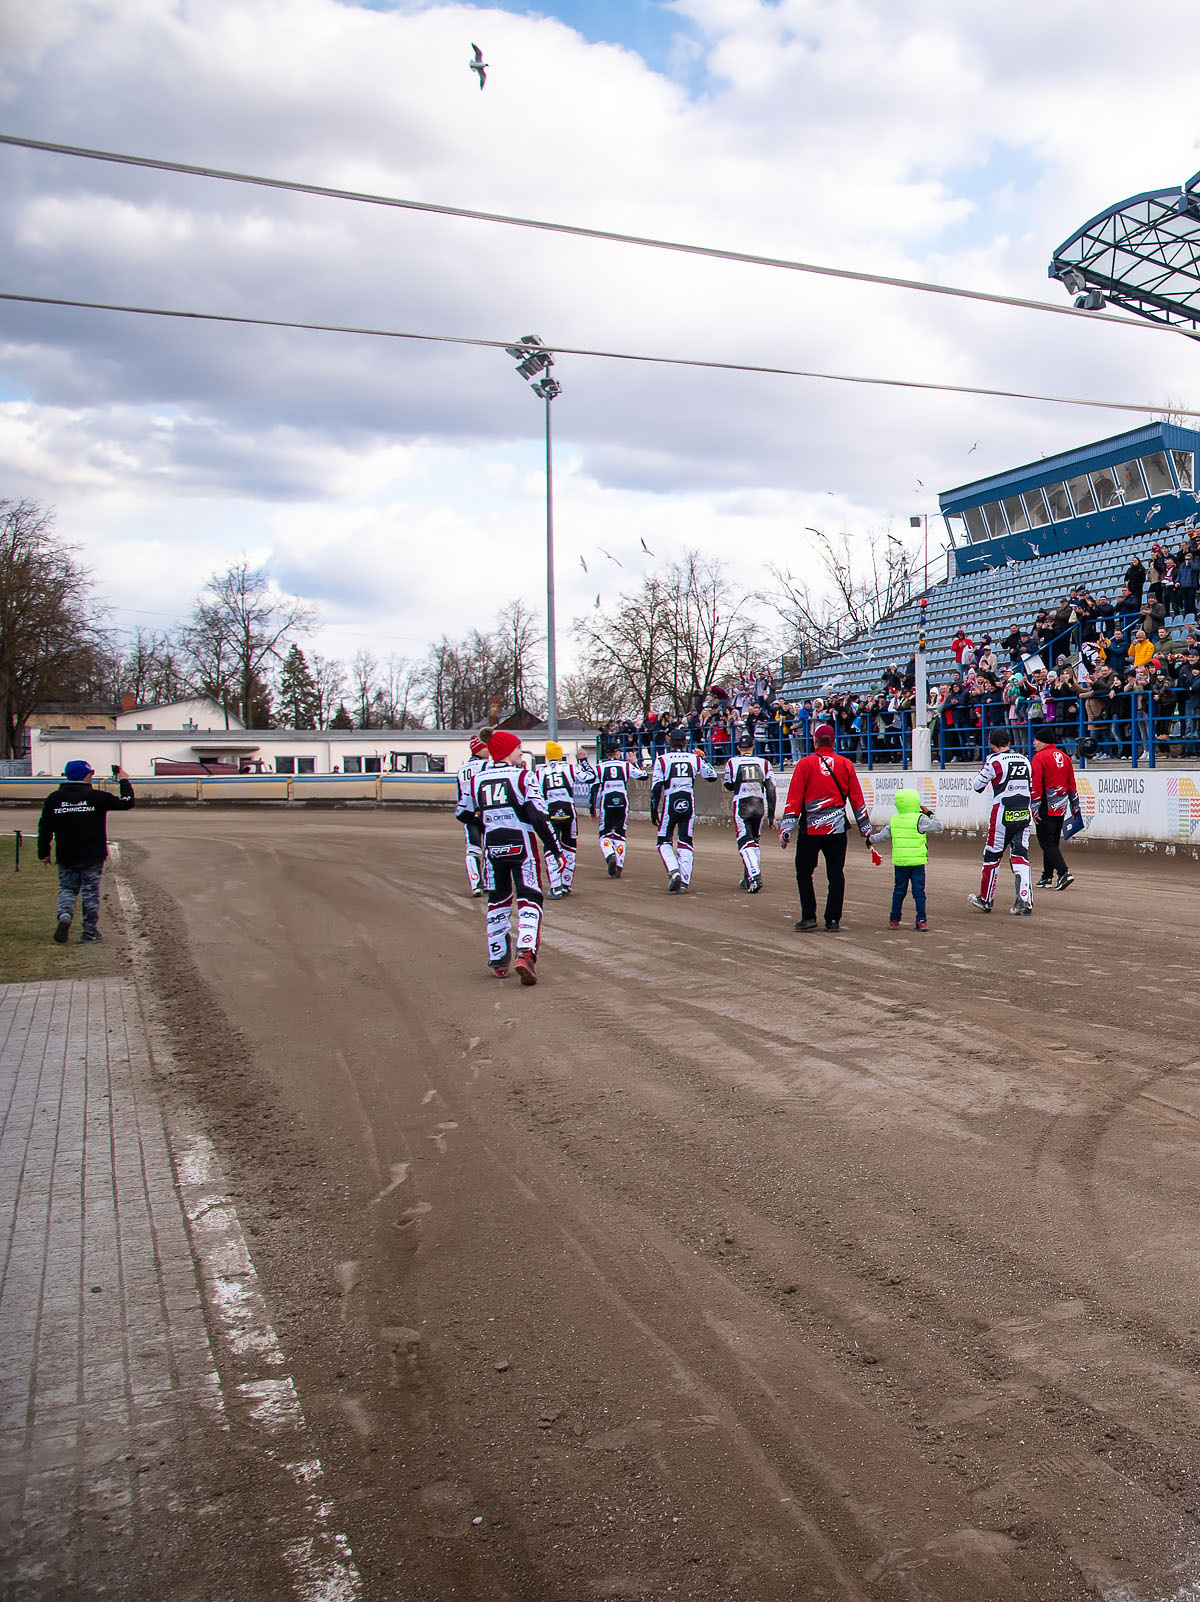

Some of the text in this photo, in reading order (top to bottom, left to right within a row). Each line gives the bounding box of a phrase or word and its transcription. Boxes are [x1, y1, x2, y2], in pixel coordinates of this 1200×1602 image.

[462, 769, 472, 782] 10
[610, 766, 618, 779] 9
[674, 762, 689, 777] 12
[743, 766, 756, 779] 11
[1010, 766, 1027, 776] 13
[546, 774, 563, 788] 15
[875, 778, 904, 790] DAUGAVPILS
[939, 778, 973, 791] DAUGAVPILS
[1098, 778, 1145, 794] DAUGAVPILS
[482, 783, 508, 806] 14
[944, 795, 970, 808] SPEEDWAY
[1098, 799, 1141, 815] IS SPEEDWAY
[54, 806, 95, 814] TECHNICZNA
